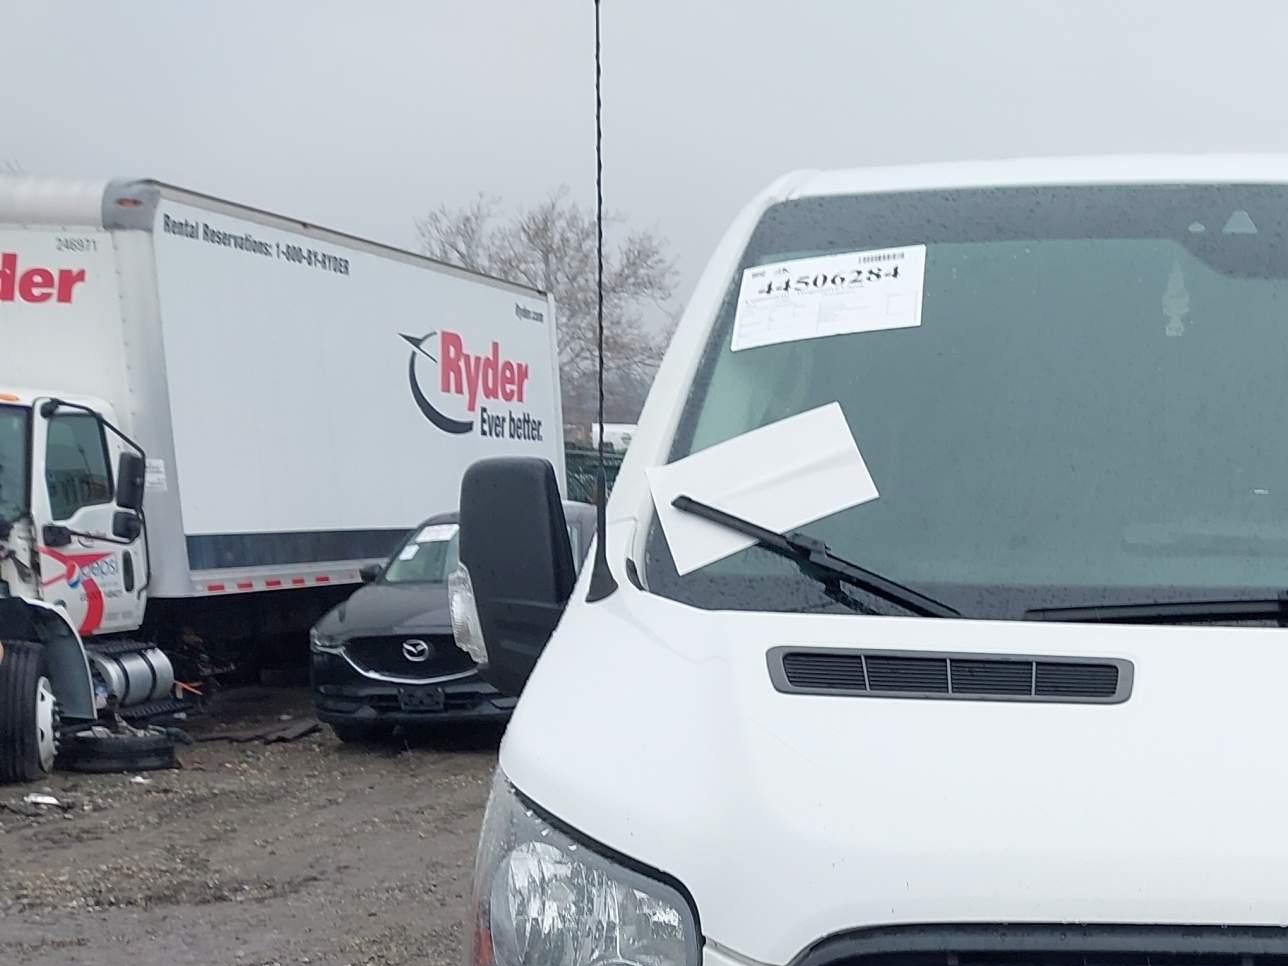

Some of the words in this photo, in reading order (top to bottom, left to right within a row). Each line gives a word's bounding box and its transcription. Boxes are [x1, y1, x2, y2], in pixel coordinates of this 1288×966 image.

[163, 214, 199, 240] Rental
[202, 223, 273, 258] Reservations:
[276, 241, 350, 275] 1-800-BY-RYDER
[758, 265, 900, 294] 44506284
[441, 330, 528, 412] Ryder
[480, 406, 507, 438] Ever
[509, 410, 543, 441] better.
